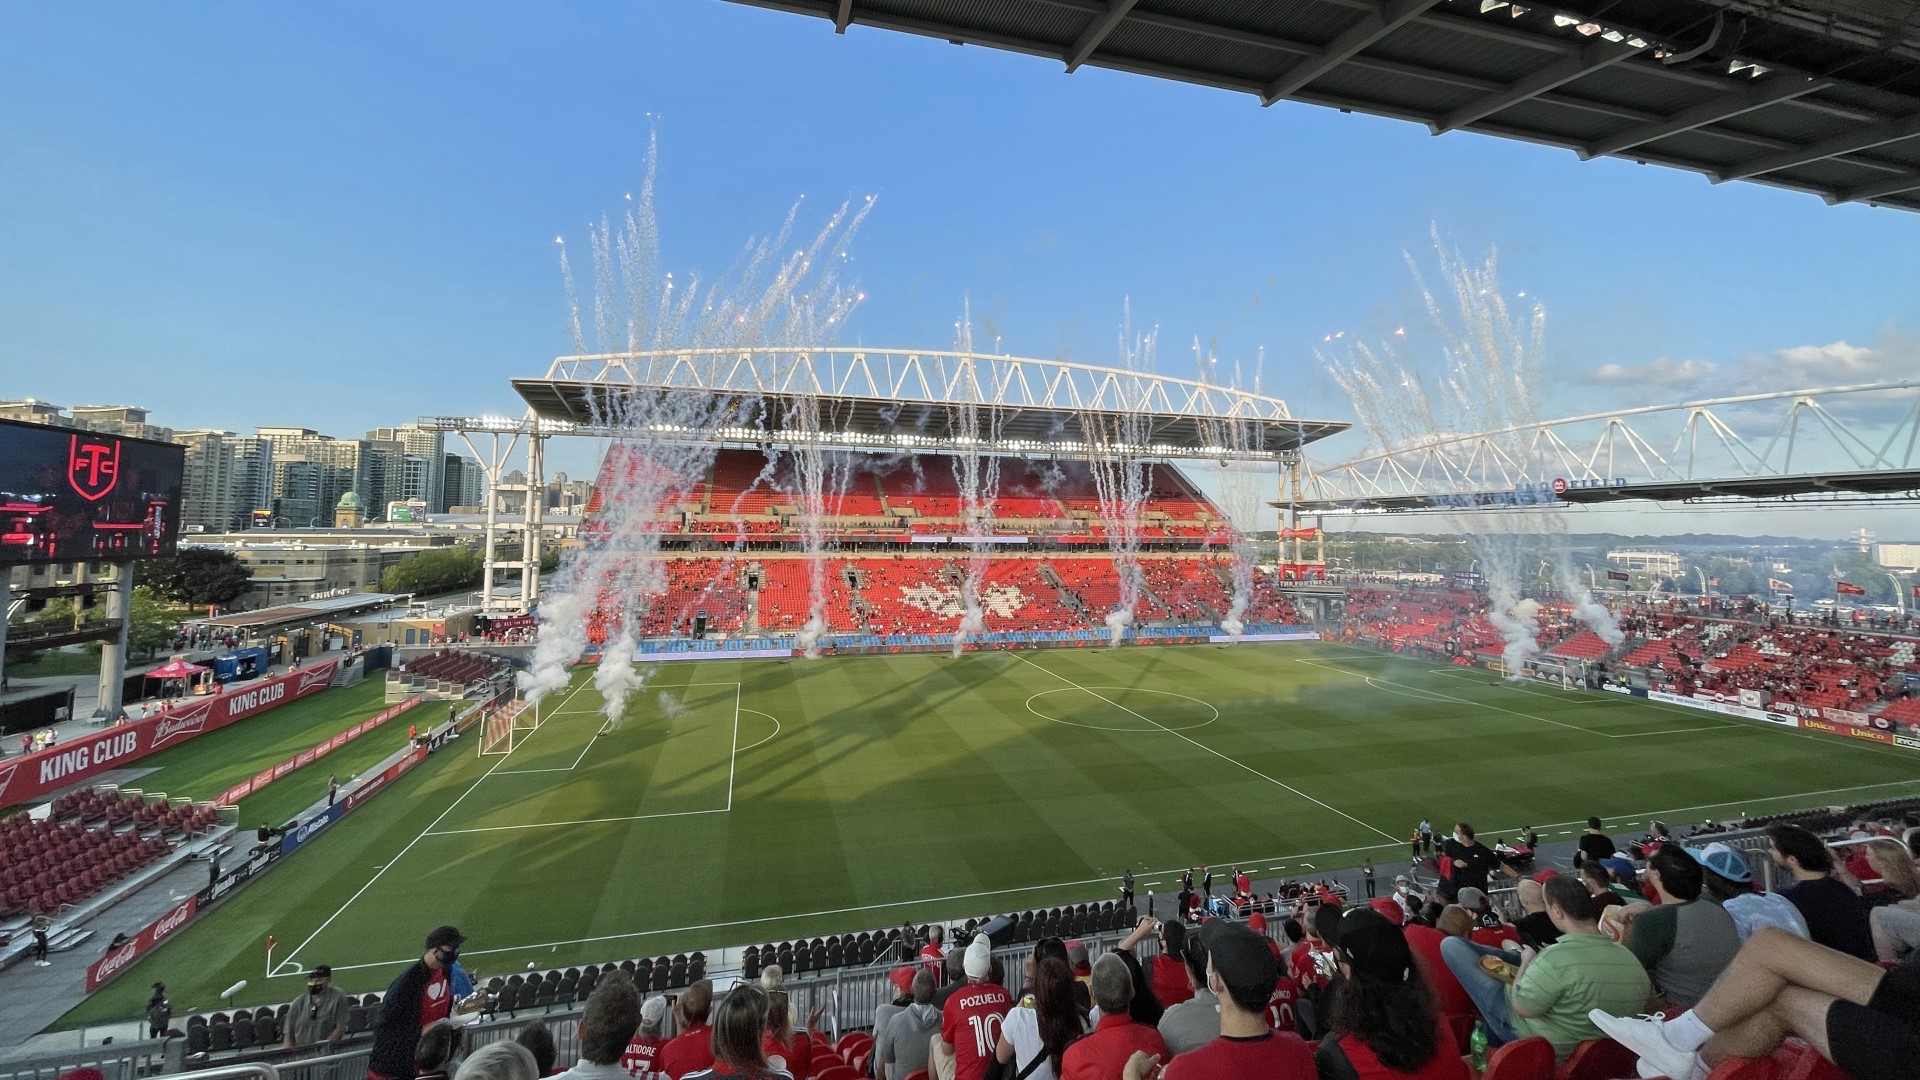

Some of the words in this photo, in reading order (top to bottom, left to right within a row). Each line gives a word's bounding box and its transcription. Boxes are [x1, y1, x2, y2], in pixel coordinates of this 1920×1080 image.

[1570, 477, 1626, 488] FIELD
[229, 692, 257, 716] KING
[259, 682, 285, 705] CLUB
[156, 712, 207, 737] Budweiser
[1804, 720, 1836, 731] Unico
[1851, 728, 1885, 740] Unico
[40, 747, 89, 784] KING
[93, 731, 137, 764] CLUB
[959, 993, 1005, 1010] POZUELO
[625, 1043, 657, 1057] ALTIDORE
